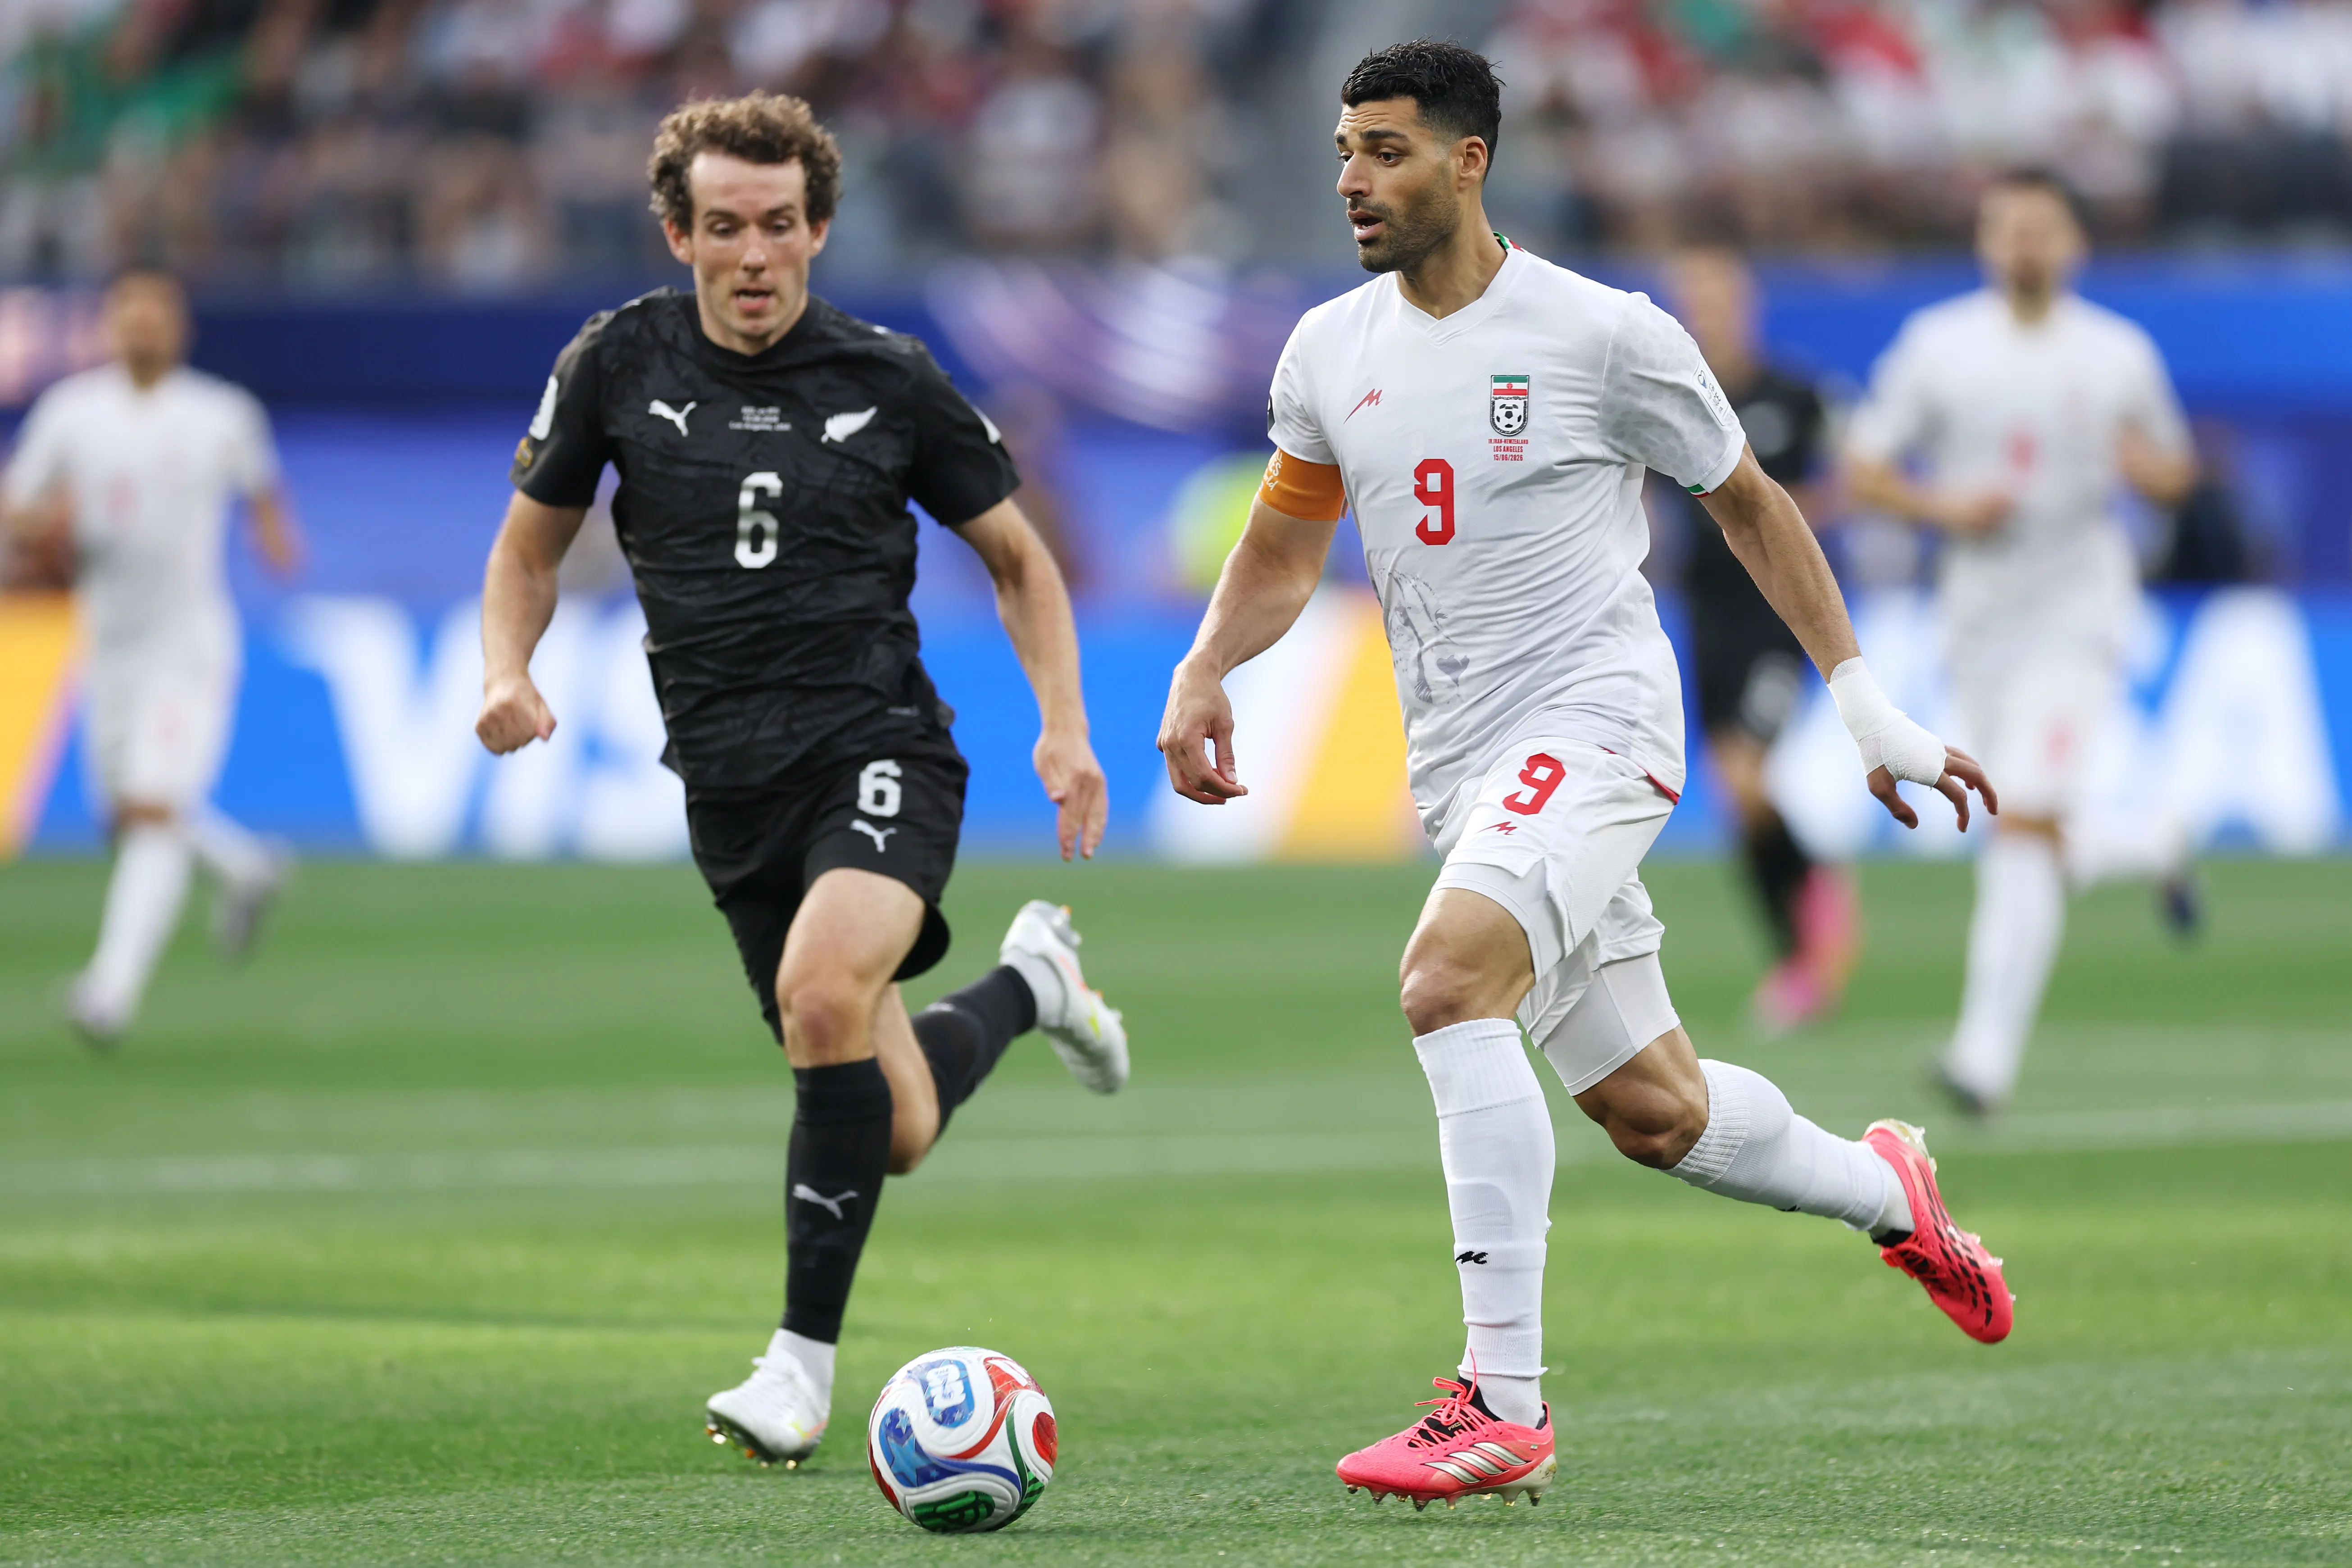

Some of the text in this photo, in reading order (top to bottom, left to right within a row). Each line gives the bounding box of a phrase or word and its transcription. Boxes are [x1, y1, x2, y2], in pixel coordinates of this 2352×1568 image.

[734, 472, 783, 568] 6
[1414, 459, 1455, 545] 9
[857, 759, 903, 818] 6
[1503, 753, 1566, 815] 9
